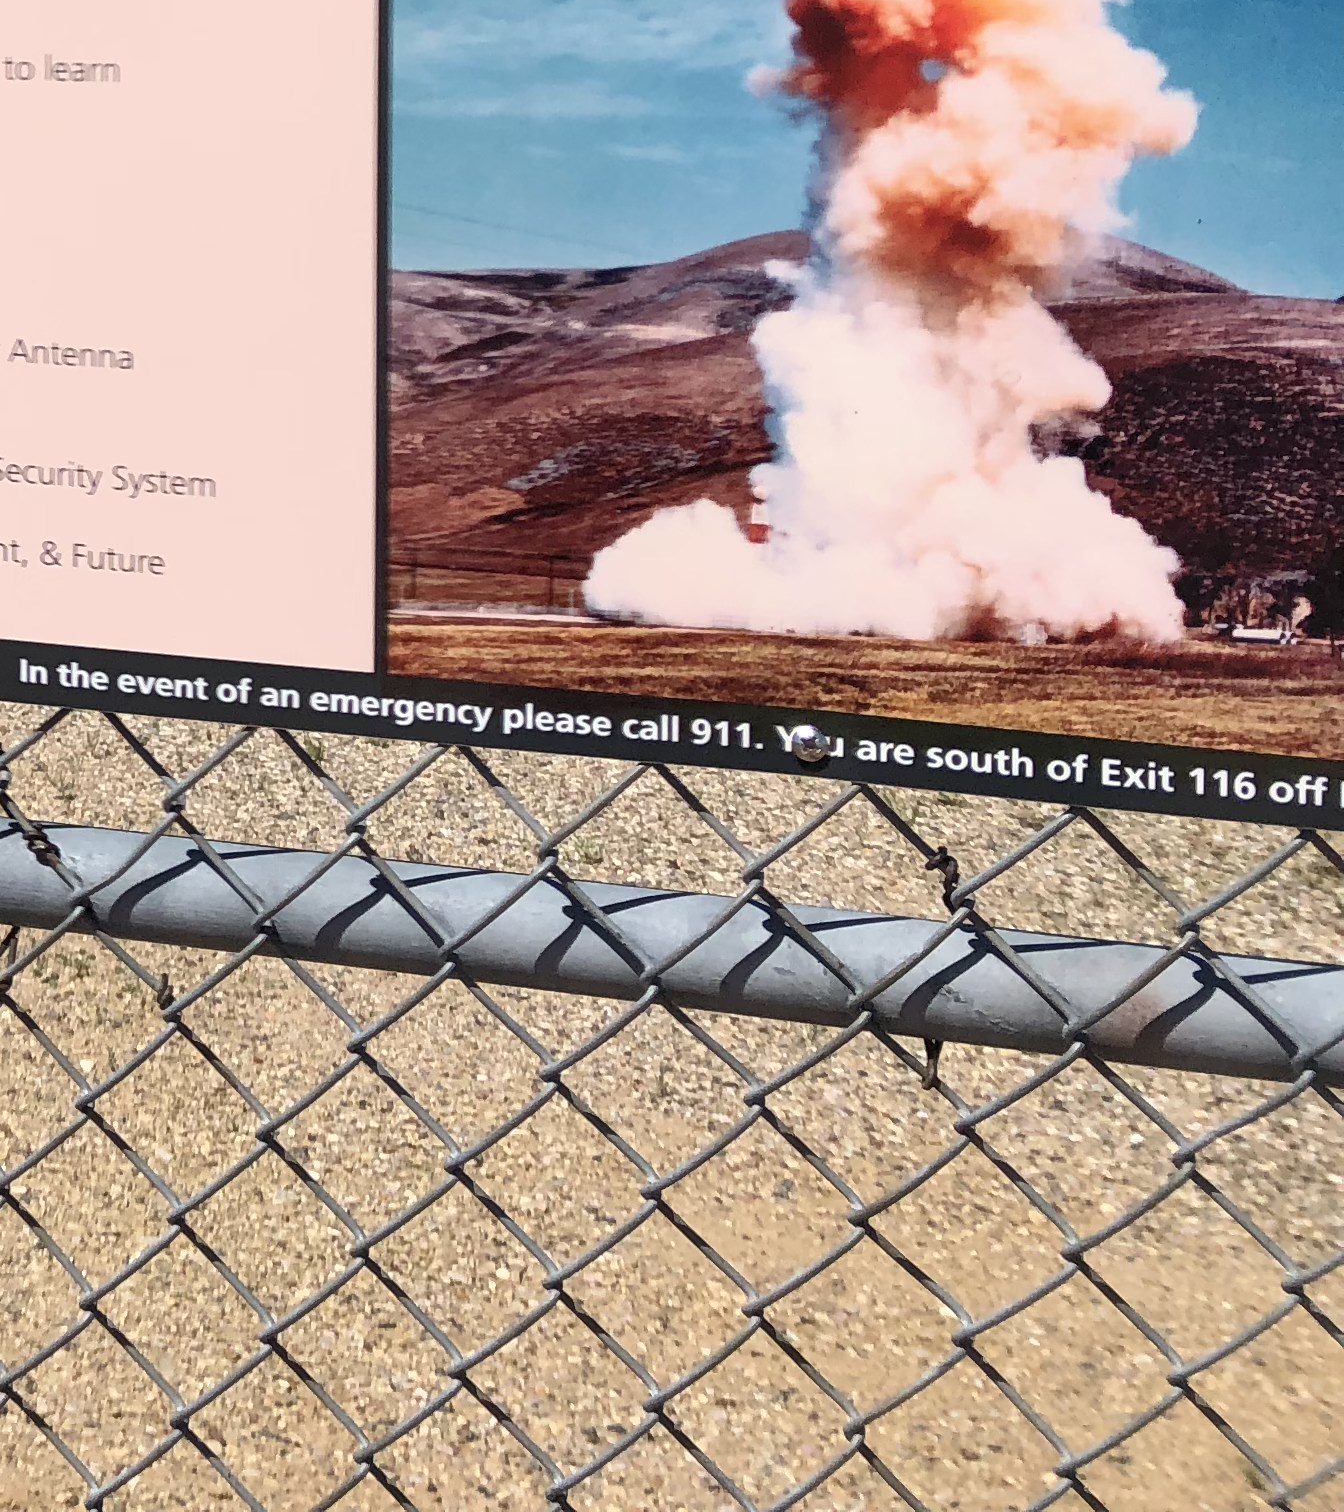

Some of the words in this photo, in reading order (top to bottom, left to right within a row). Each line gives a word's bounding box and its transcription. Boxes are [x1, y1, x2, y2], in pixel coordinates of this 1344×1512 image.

[1, 55, 36, 82] to
[44, 53, 121, 83] learn
[7, 337, 134, 371] Antenna
[111, 464, 216, 500] System
[39, 539, 62, 568] &
[72, 542, 166, 577] Future
[19, 657, 49, 686] In
[55, 660, 110, 692] the
[116, 673, 210, 702] event
[215, 676, 253, 705] of
[259, 686, 301, 710] an
[308, 690, 494, 733] emergency
[502, 701, 612, 738] please
[621, 713, 680, 744] call
[690, 717, 764, 751] 911.
[774, 724, 846, 759] Yu
[854, 738, 915, 767] are
[926, 745, 1034, 779] south
[1046, 753, 1089, 784] of
[1100, 757, 1175, 794] Exit
[1188, 766, 1257, 801] 116
[1268, 774, 1329, 807] off
